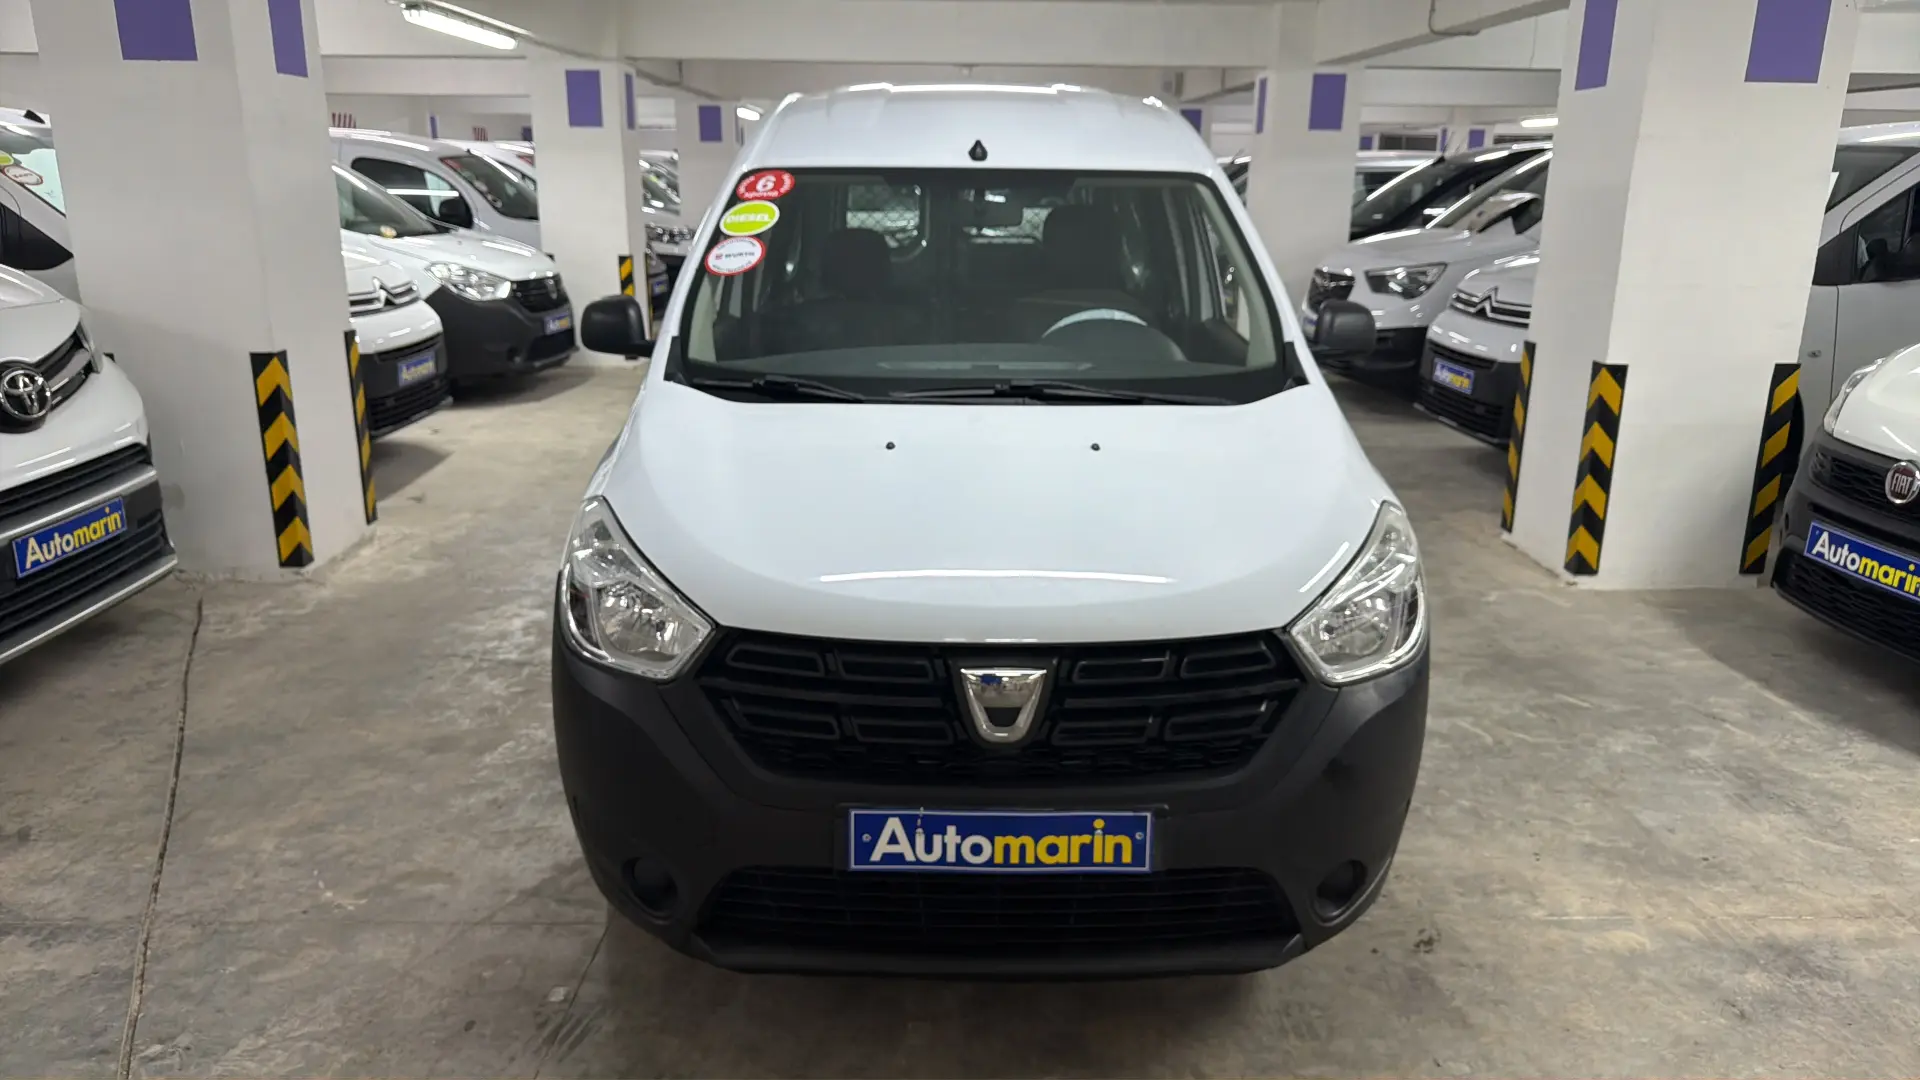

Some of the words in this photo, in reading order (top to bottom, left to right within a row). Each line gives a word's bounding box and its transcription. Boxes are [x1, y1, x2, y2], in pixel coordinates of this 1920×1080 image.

[755, 174, 776, 193] 6
[726, 212, 770, 225] DIESEL
[1891, 473, 1913, 495] FIAT
[24, 506, 122, 570] Automarin
[869, 816, 1134, 866] Automarin
